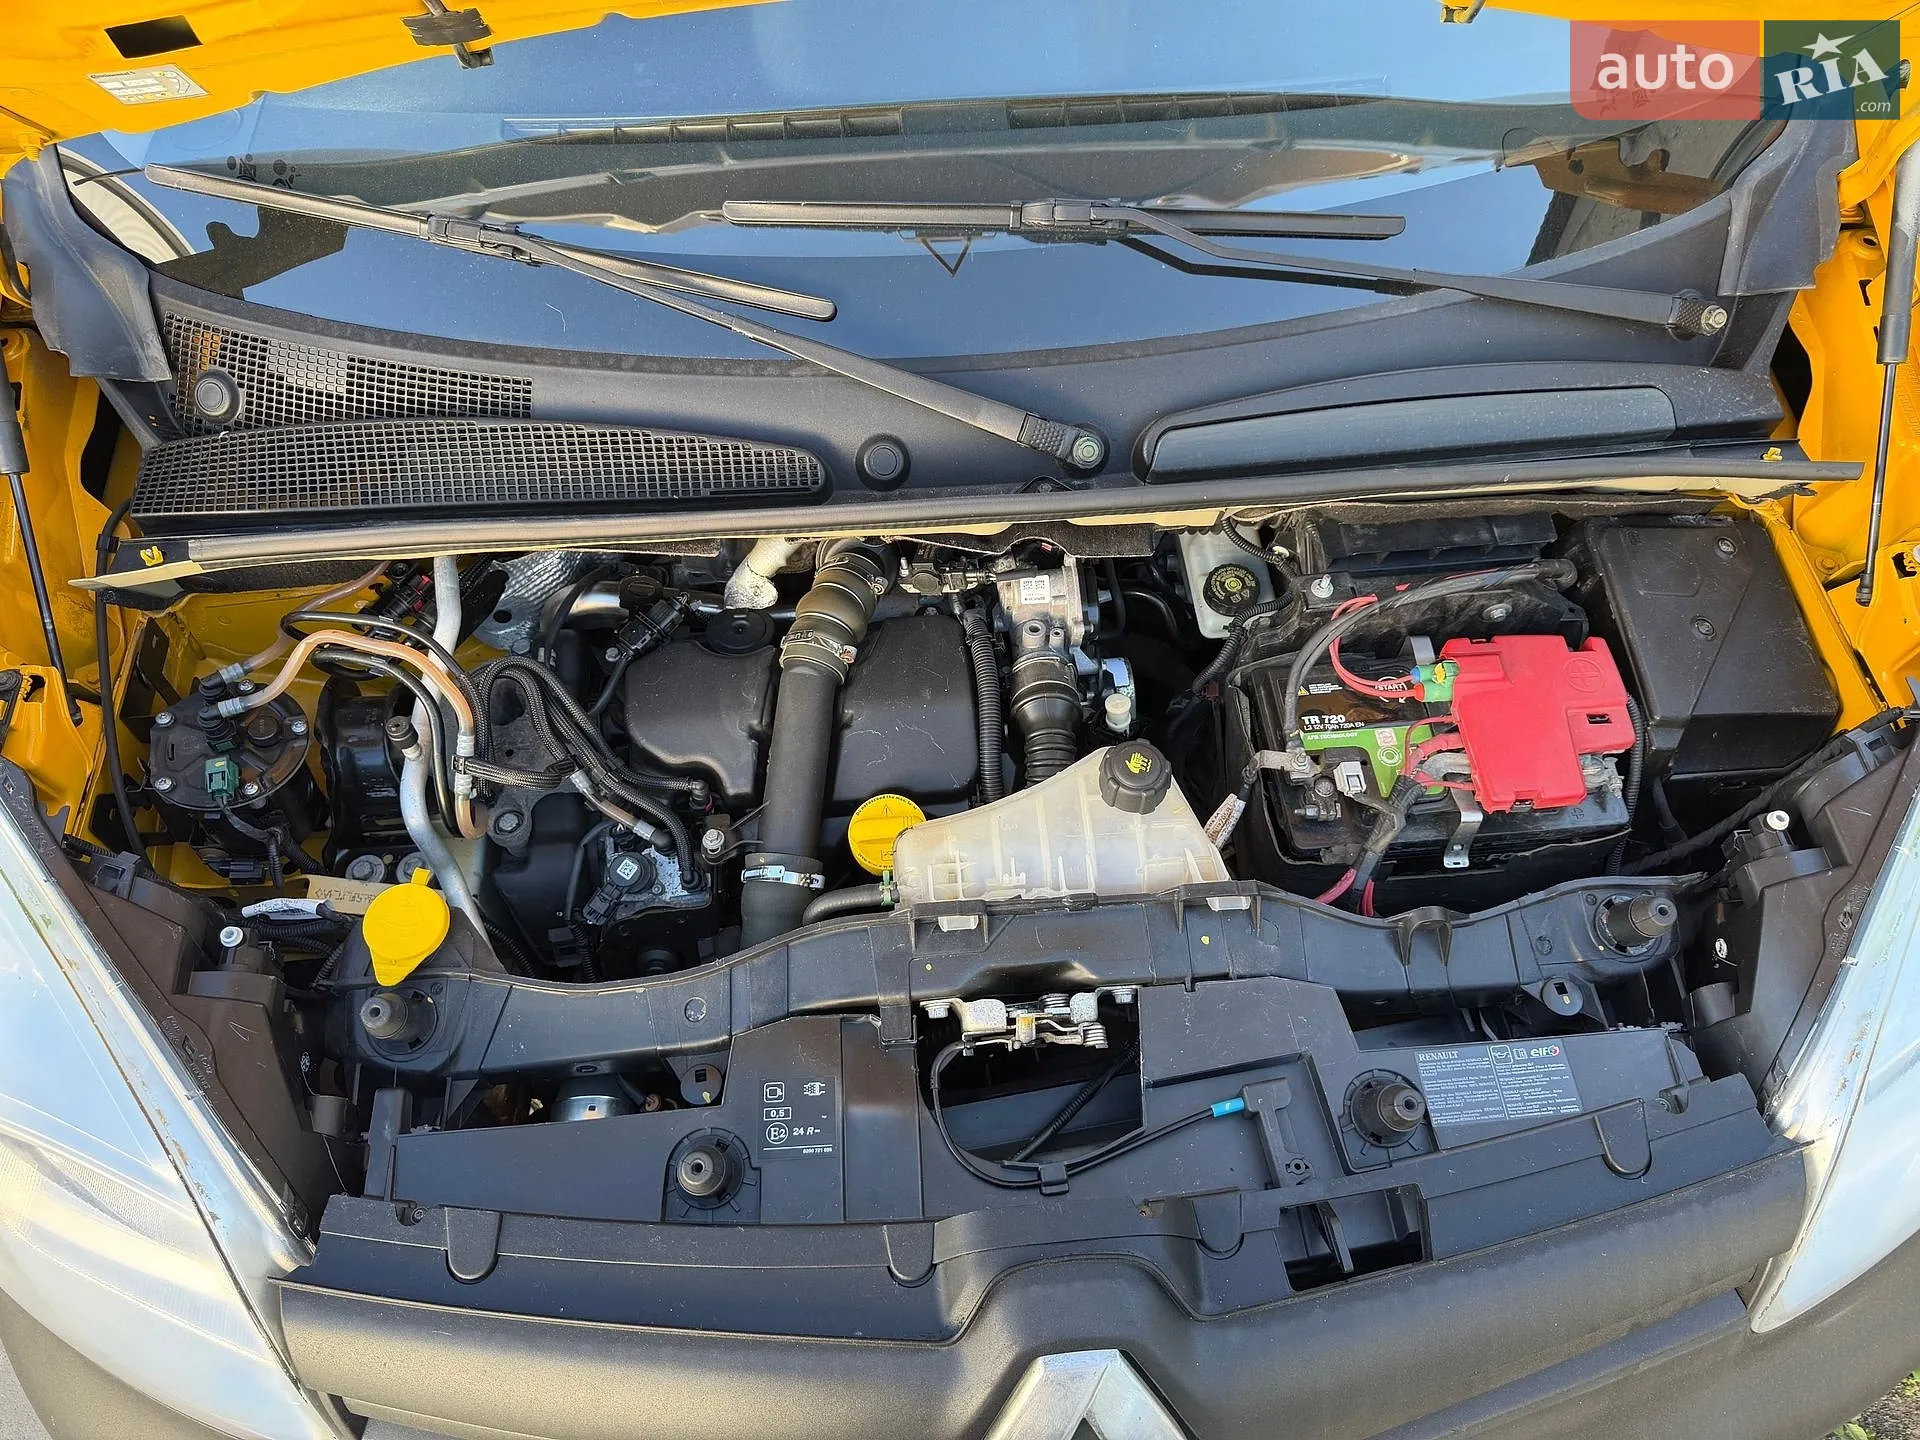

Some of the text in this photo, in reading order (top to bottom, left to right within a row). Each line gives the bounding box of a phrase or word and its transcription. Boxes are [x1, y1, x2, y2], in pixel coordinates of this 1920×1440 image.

[1301, 714, 1346, 724] TR 720
[1418, 1050, 1458, 1061] RENAULT
[1530, 1047, 1549, 1056] elf
[770, 1109, 785, 1118] 0,5
[770, 1127, 786, 1140] E2
[792, 1127, 805, 1136] 24
